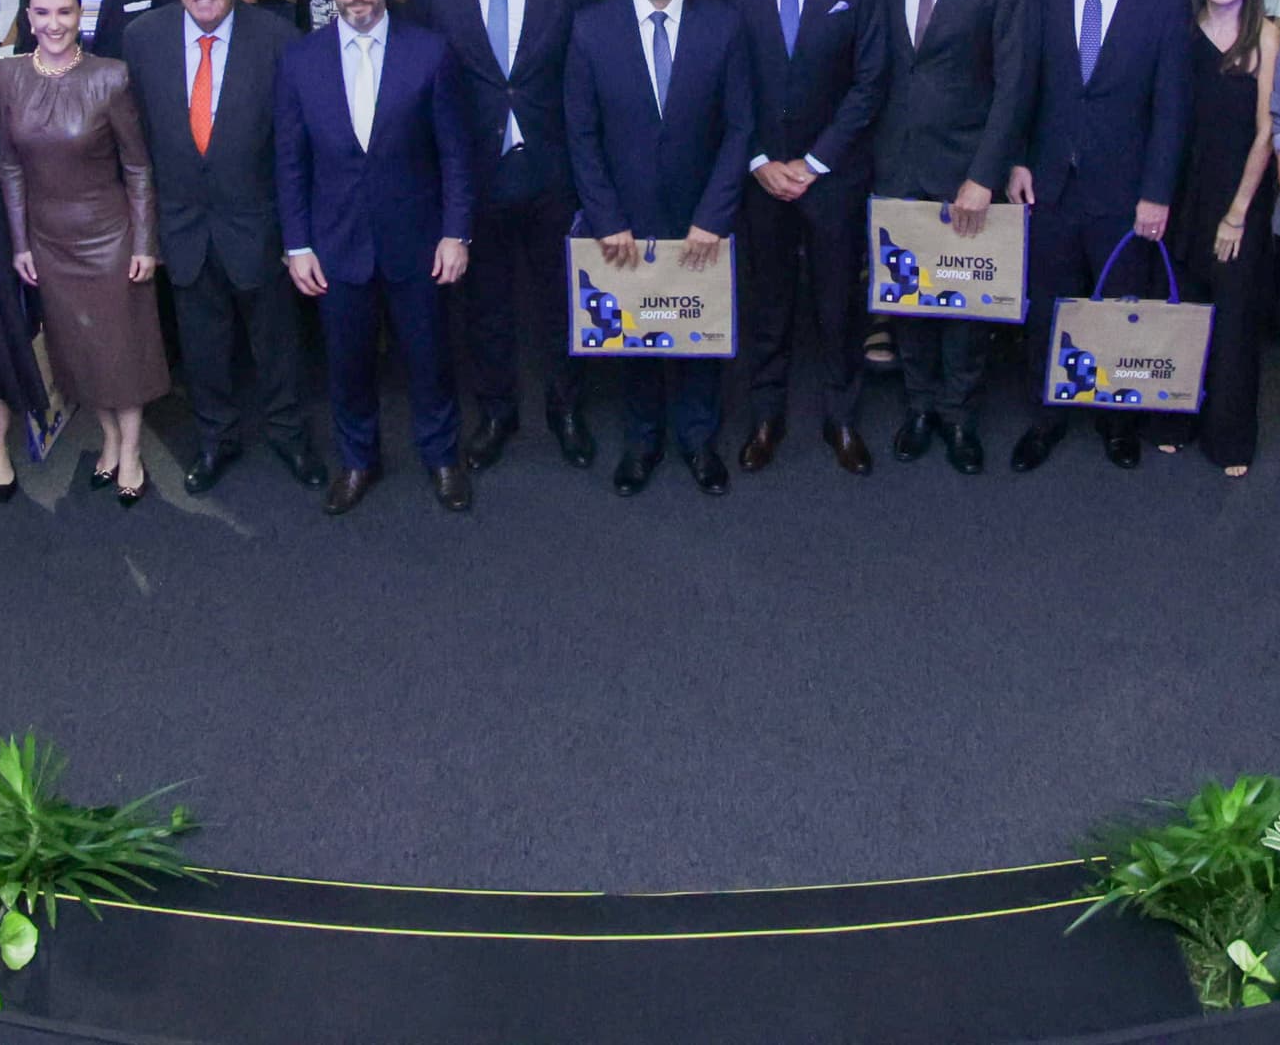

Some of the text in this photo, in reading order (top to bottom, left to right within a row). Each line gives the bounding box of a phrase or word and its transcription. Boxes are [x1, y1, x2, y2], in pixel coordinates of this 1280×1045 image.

[936, 255, 997, 272] JUNTOS,
[935, 269, 994, 282] somos RIB
[639, 296, 705, 309] JUNTOS,
[639, 308, 702, 320] somos RIB
[1115, 357, 1176, 372] JUNTOS,
[1114, 369, 1173, 380] somos RIB
